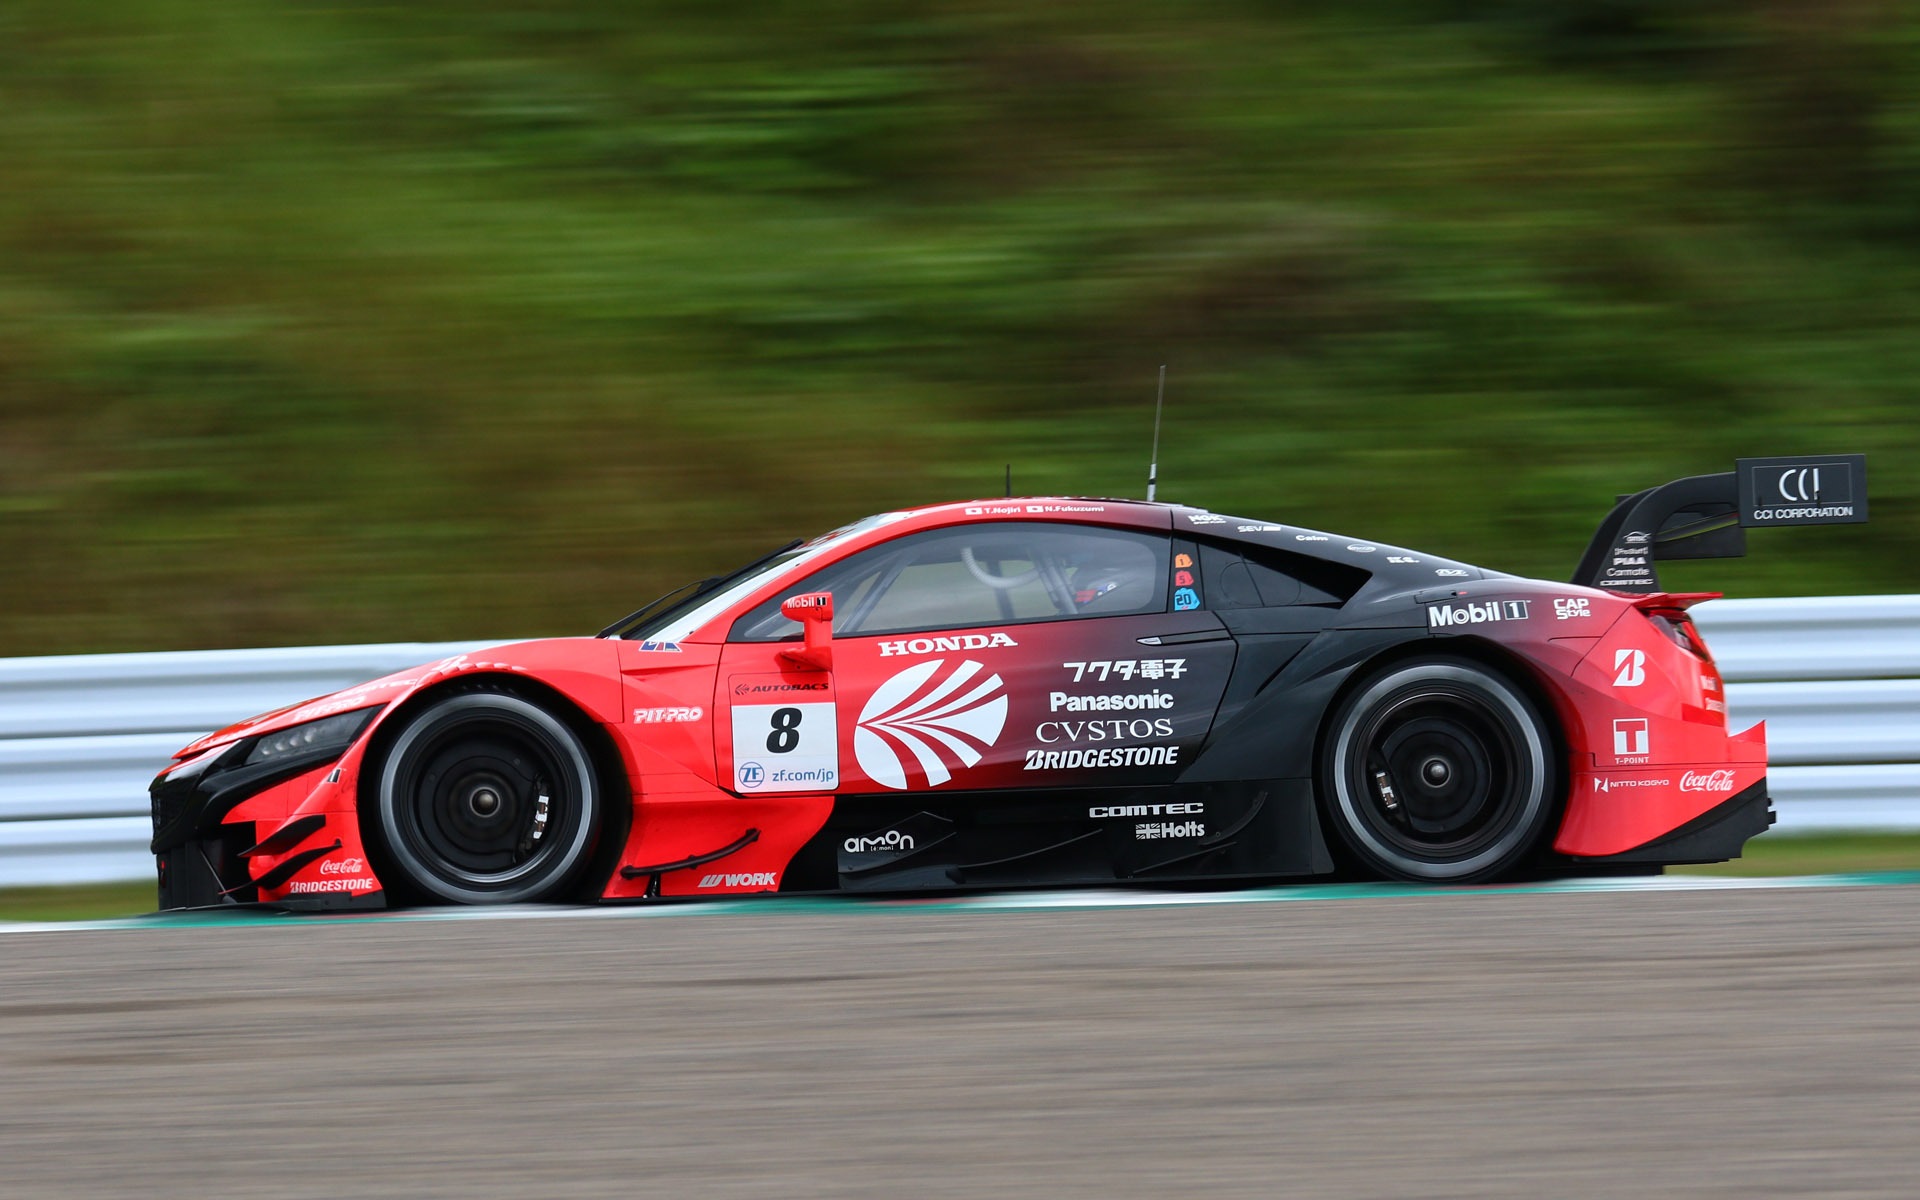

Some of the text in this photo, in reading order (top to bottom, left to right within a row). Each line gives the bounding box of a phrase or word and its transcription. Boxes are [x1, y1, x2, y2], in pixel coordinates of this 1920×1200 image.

[1779, 468, 1819, 501] CCI
[1754, 506, 1853, 520] CCI CORPORATION
[787, 597, 814, 609] Mobil
[1176, 594, 1191, 606] 20
[1553, 598, 1589, 609] CAP
[1429, 602, 1501, 627] Mobil
[878, 633, 1018, 657] HONDA
[752, 682, 829, 694] AUTOBACS
[1050, 689, 1174, 712] Panasonic
[766, 707, 803, 754] 8
[1036, 718, 1173, 743] CVSTOS
[1024, 746, 1179, 770] BRIDGESTONE
[1615, 757, 1649, 765] T-POINT
[772, 770, 834, 783] zf.com/jp
[1089, 803, 1204, 818] COMTEC
[1161, 821, 1205, 838] Holts
[844, 830, 914, 853] amon
[289, 879, 373, 894] BRIDGESTONE
[725, 872, 776, 887] WORK
